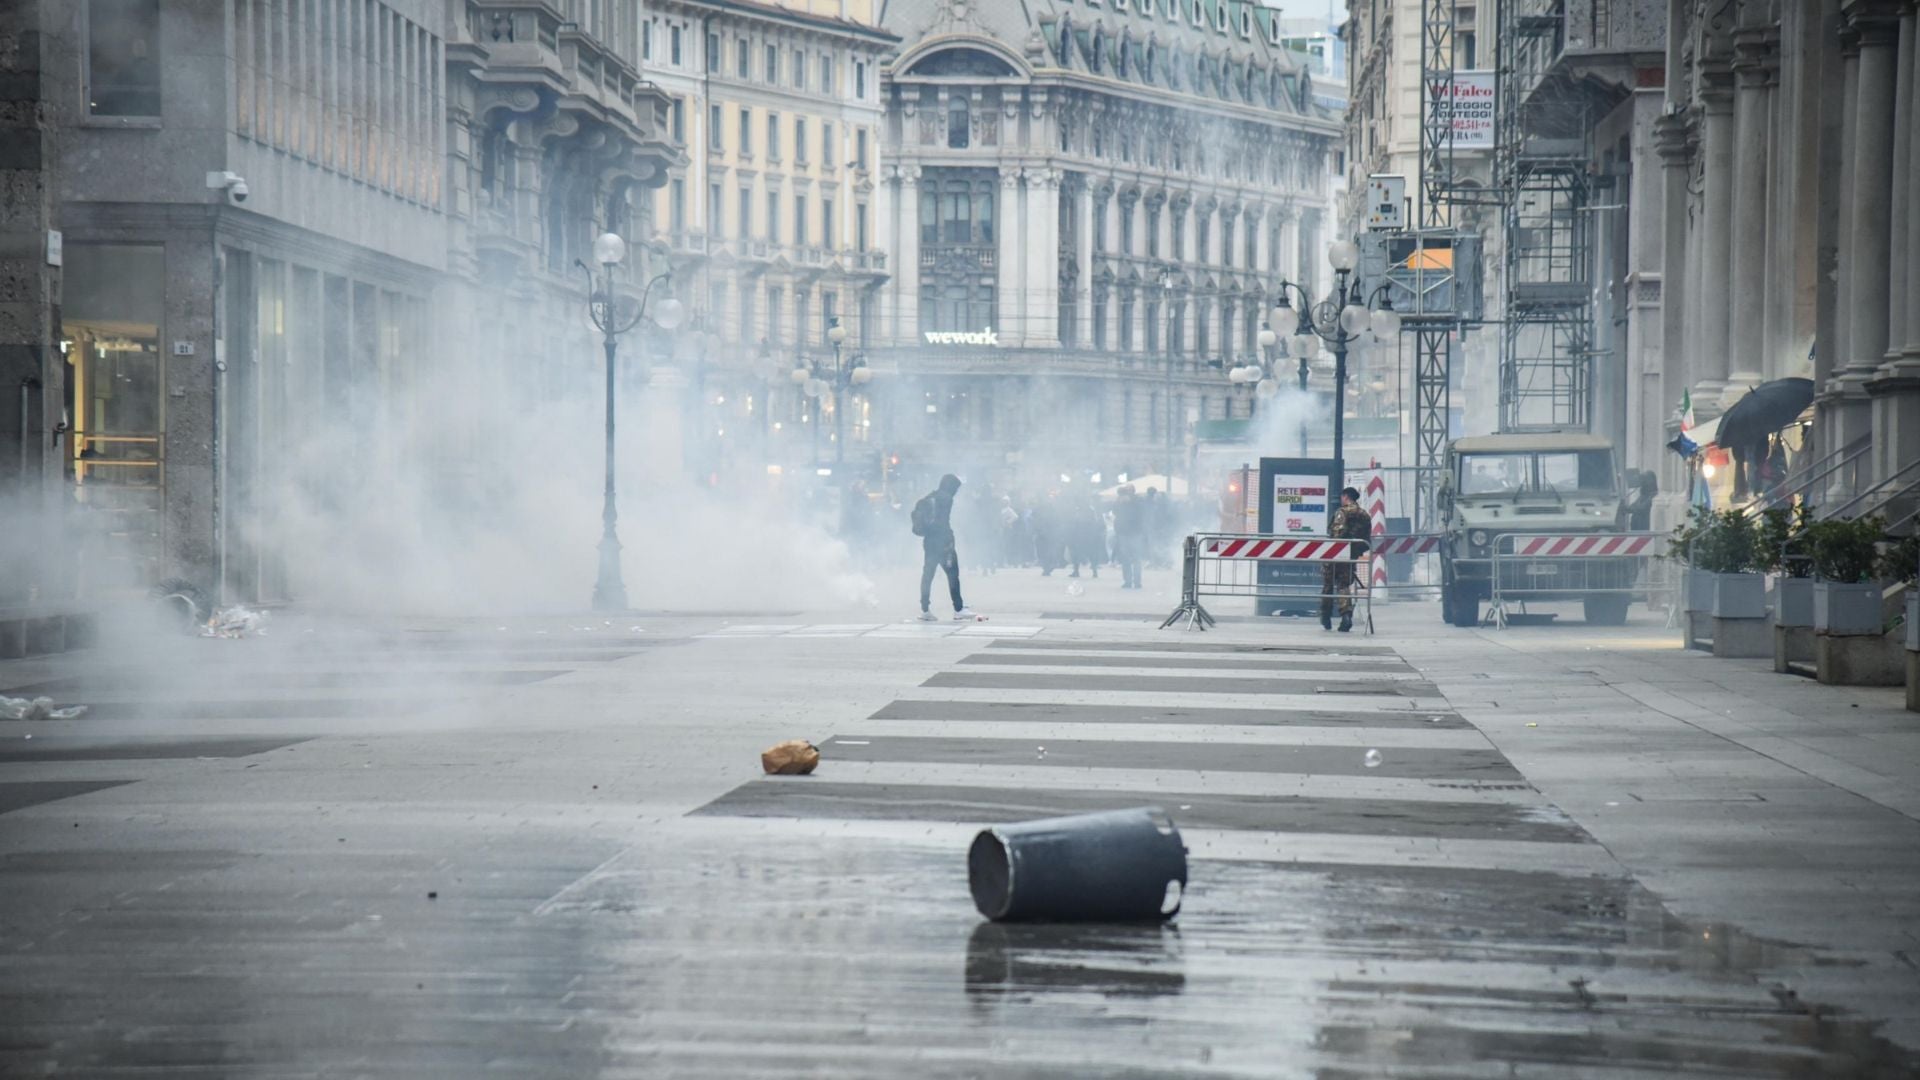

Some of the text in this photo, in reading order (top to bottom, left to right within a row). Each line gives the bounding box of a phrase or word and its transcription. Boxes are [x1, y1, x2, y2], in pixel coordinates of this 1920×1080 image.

[1454, 85, 1492, 96] Falco
[924, 326, 999, 345] wework
[1277, 487, 1299, 495] RETE
[1286, 519, 1302, 528] 25
